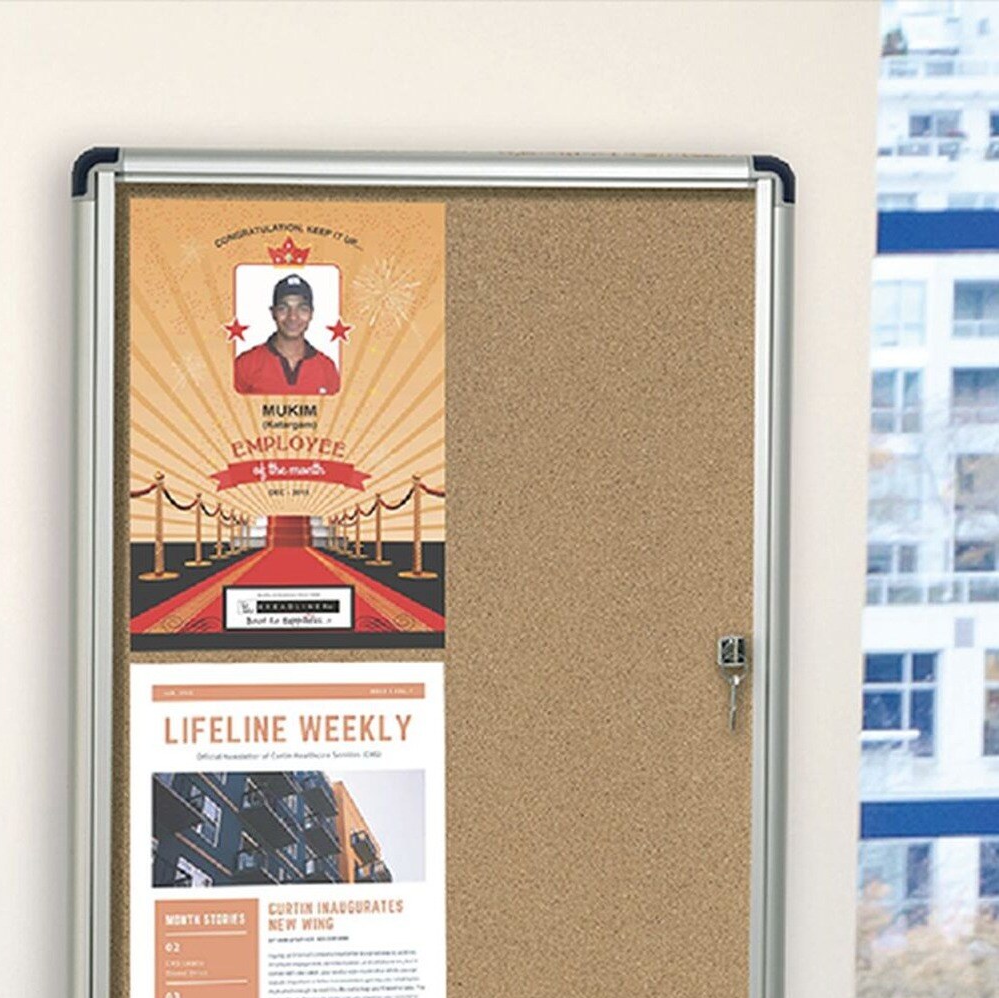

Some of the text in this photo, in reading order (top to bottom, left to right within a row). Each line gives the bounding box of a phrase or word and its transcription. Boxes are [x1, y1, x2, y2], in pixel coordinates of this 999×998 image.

[307, 226, 332, 237] KEEP
[333, 231, 343, 241] IT
[262, 404, 317, 417] MUKIM
[230, 435, 346, 458] EMPLOYEE
[252, 461, 326, 482] of the month
[165, 714, 412, 744] LIFELINE WEEKLY
[268, 900, 404, 915] CURTIN INAUGURATES
[203, 913, 246, 925] STORIES
[268, 917, 334, 931] NEW WING
[165, 942, 180, 952] 02
